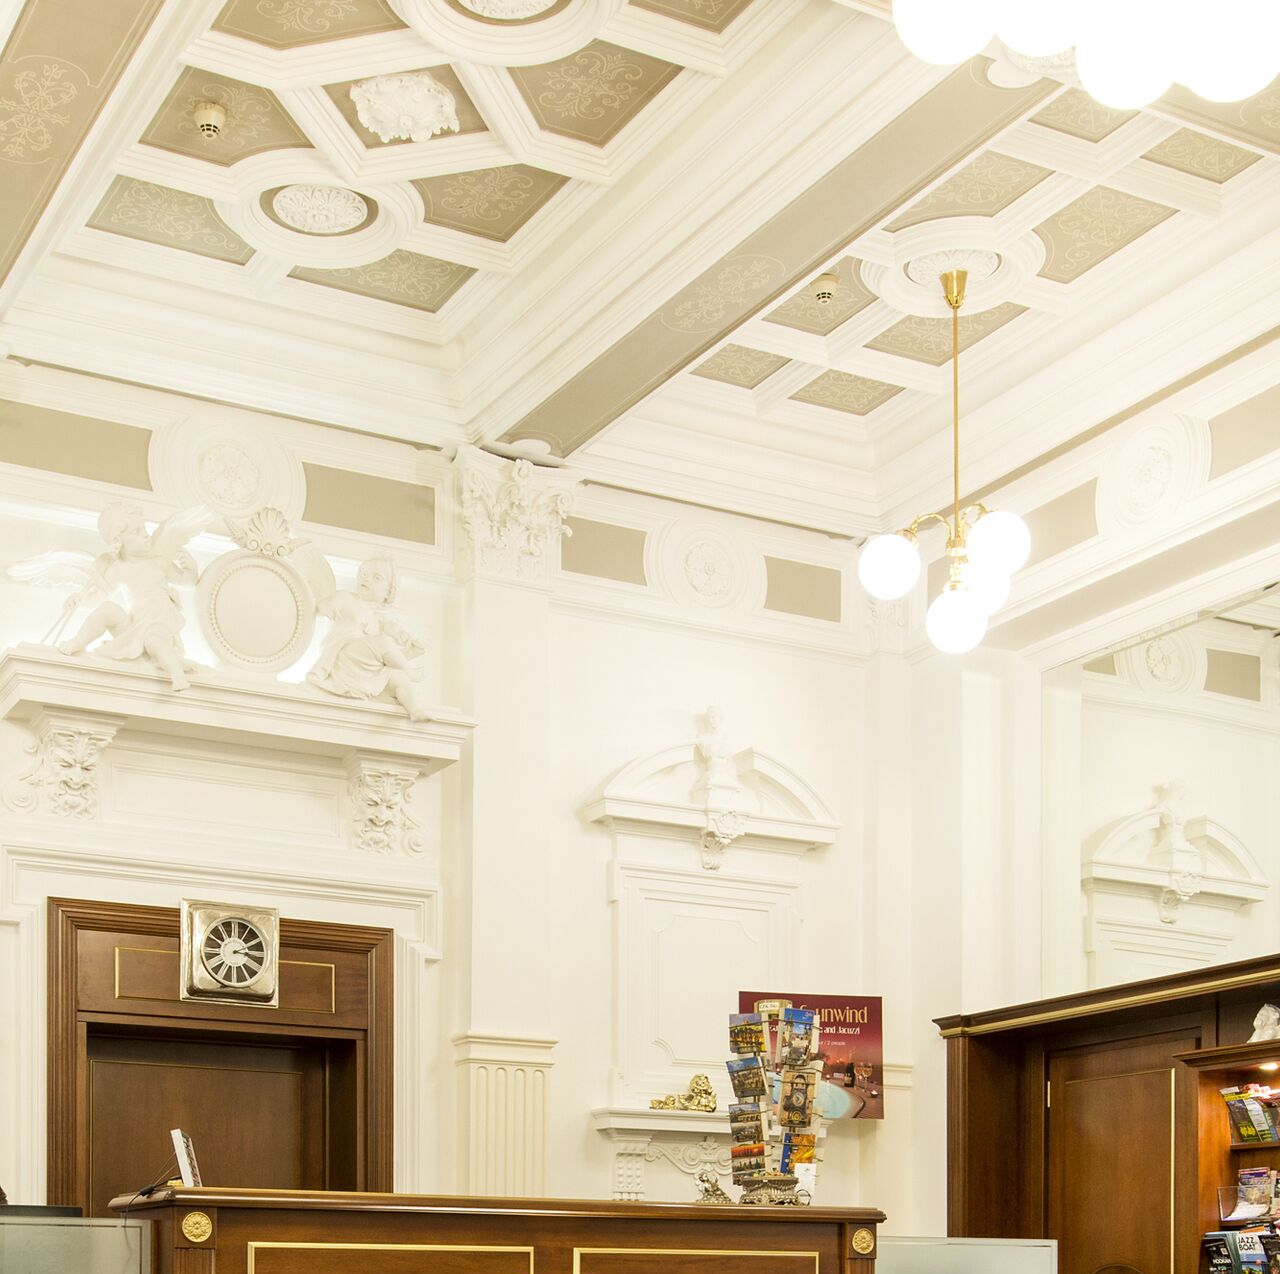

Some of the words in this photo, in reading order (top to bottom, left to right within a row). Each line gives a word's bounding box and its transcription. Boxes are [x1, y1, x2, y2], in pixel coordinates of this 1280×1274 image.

[816, 1006, 868, 1024] unwind
[824, 1026, 836, 1034] and
[1237, 1236, 1254, 1244] JAZZ
[1239, 1243, 1256, 1251] BOAT
